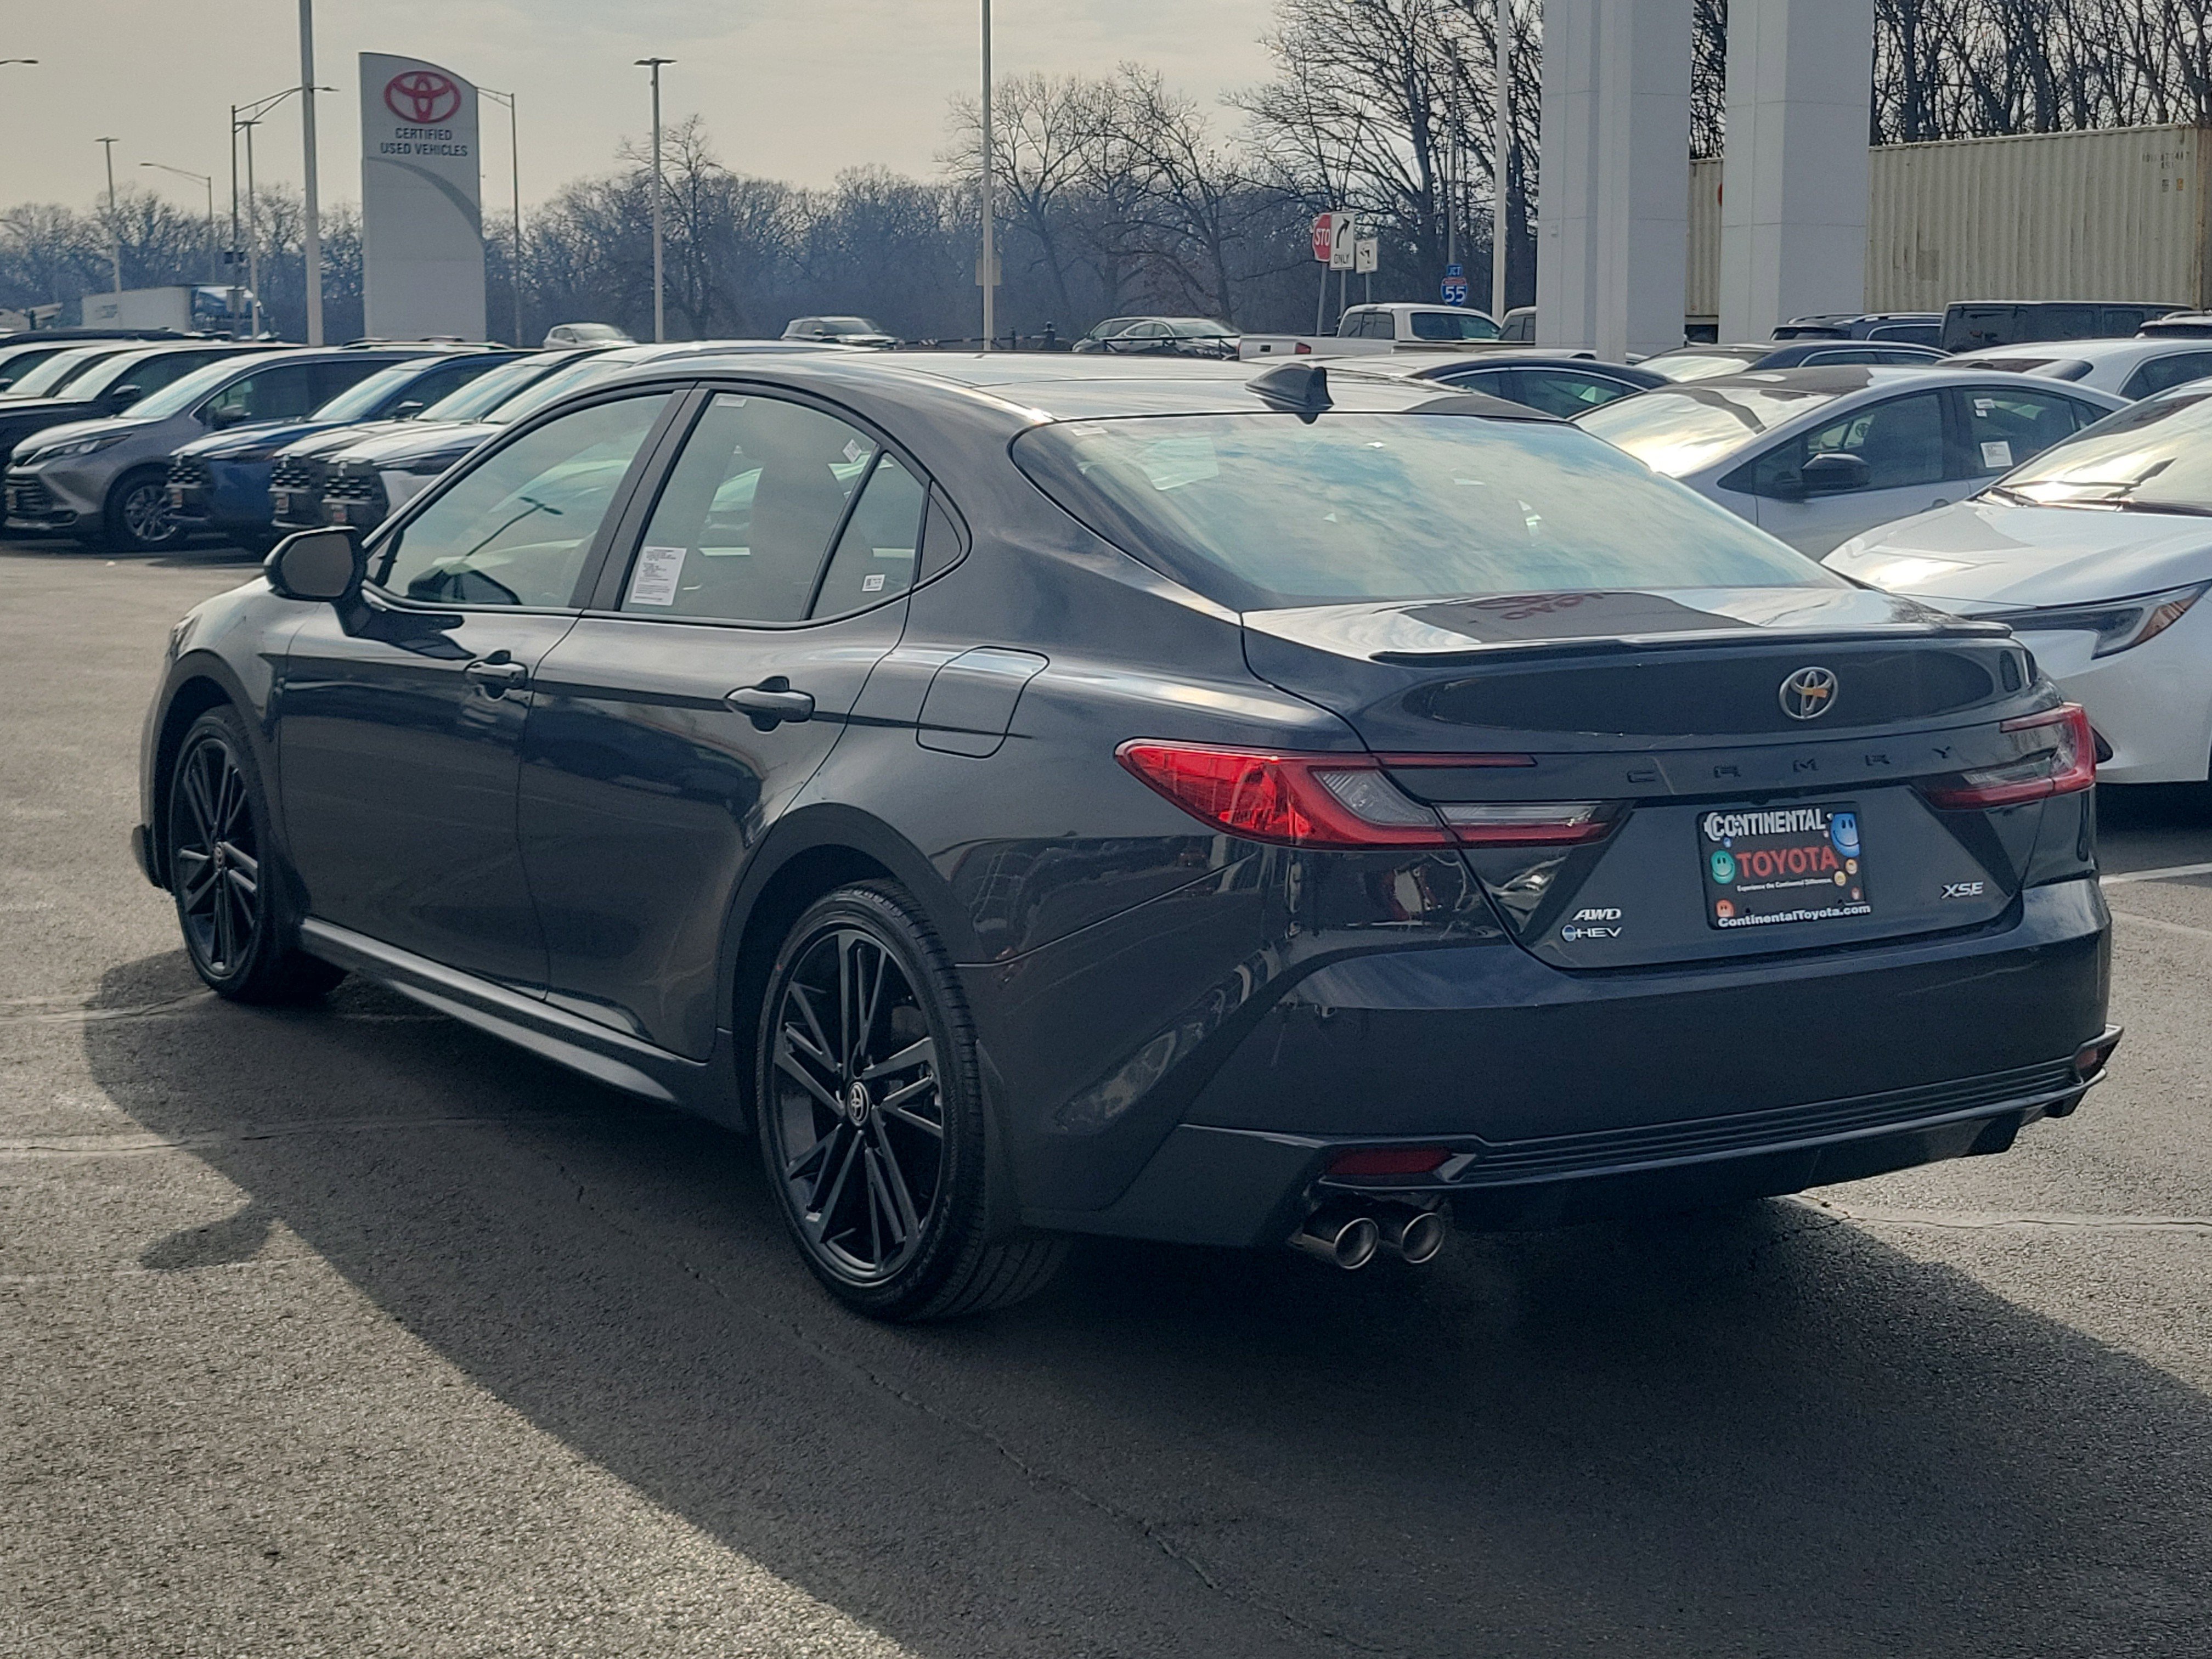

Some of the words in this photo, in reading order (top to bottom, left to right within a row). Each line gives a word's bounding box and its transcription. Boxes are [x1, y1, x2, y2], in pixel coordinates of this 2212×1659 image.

[396, 128, 452, 140] CERTIFIED
[380, 143, 410, 154] USED
[415, 143, 468, 156] VEHICLES
[1314, 228, 1330, 246] STO
[1334, 253, 1350, 264] ONLY
[1446, 286, 1465, 302] 55
[1627, 746, 1951, 783] CAMRY
[1704, 808, 1826, 840] CONTINENTAL
[1735, 845, 1838, 878] TOYOTA
[1941, 881, 1984, 899] XSE
[1572, 908, 1622, 921] AWD
[1718, 905, 1871, 927] ContinentalToyota.com
[1576, 927, 1622, 938] HEV
